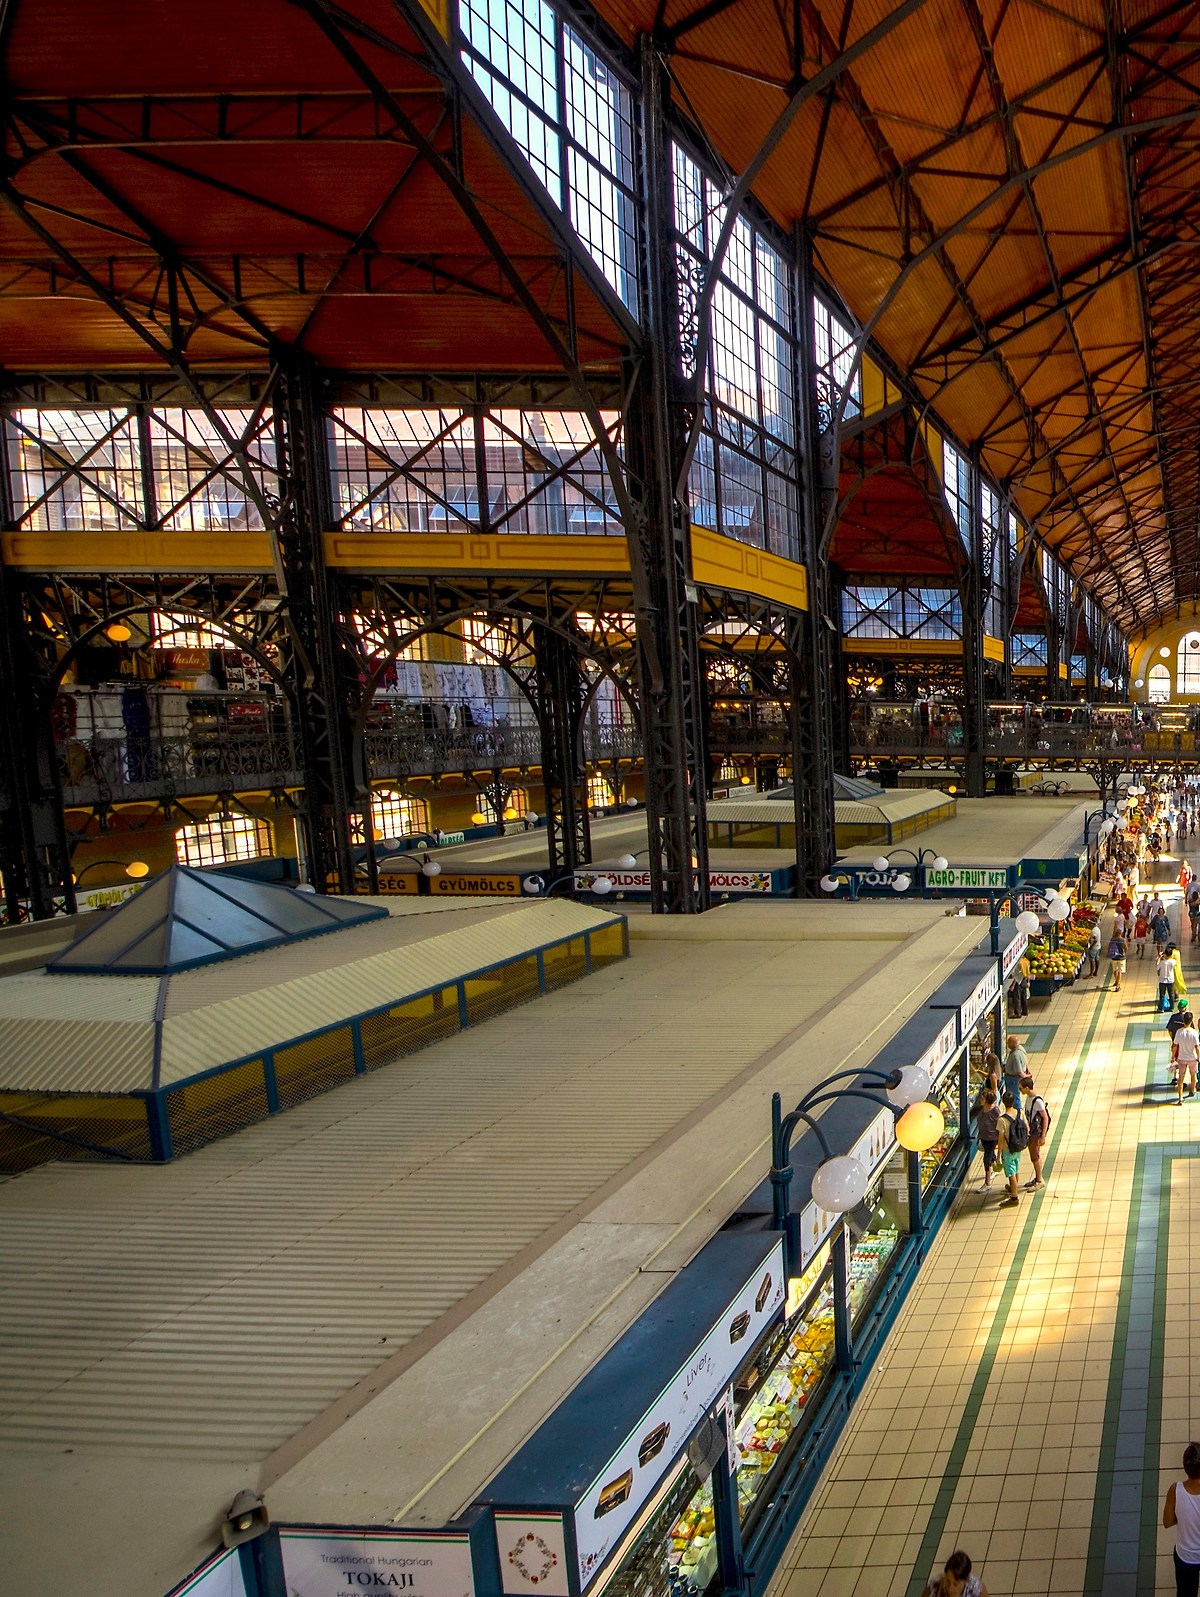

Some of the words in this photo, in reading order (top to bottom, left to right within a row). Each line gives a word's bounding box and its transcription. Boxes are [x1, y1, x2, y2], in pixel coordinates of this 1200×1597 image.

[440, 877, 515, 892] GYÜMÖLCS
[599, 872, 651, 887] ÖLDSÉ
[929, 870, 986, 886] AGRO-FRUIT
[686, 1352, 709, 1387] Liver
[320, 1553, 375, 1566] Traditional
[378, 1556, 433, 1568] Hungarian
[343, 1571, 415, 1589] TOKAJI
